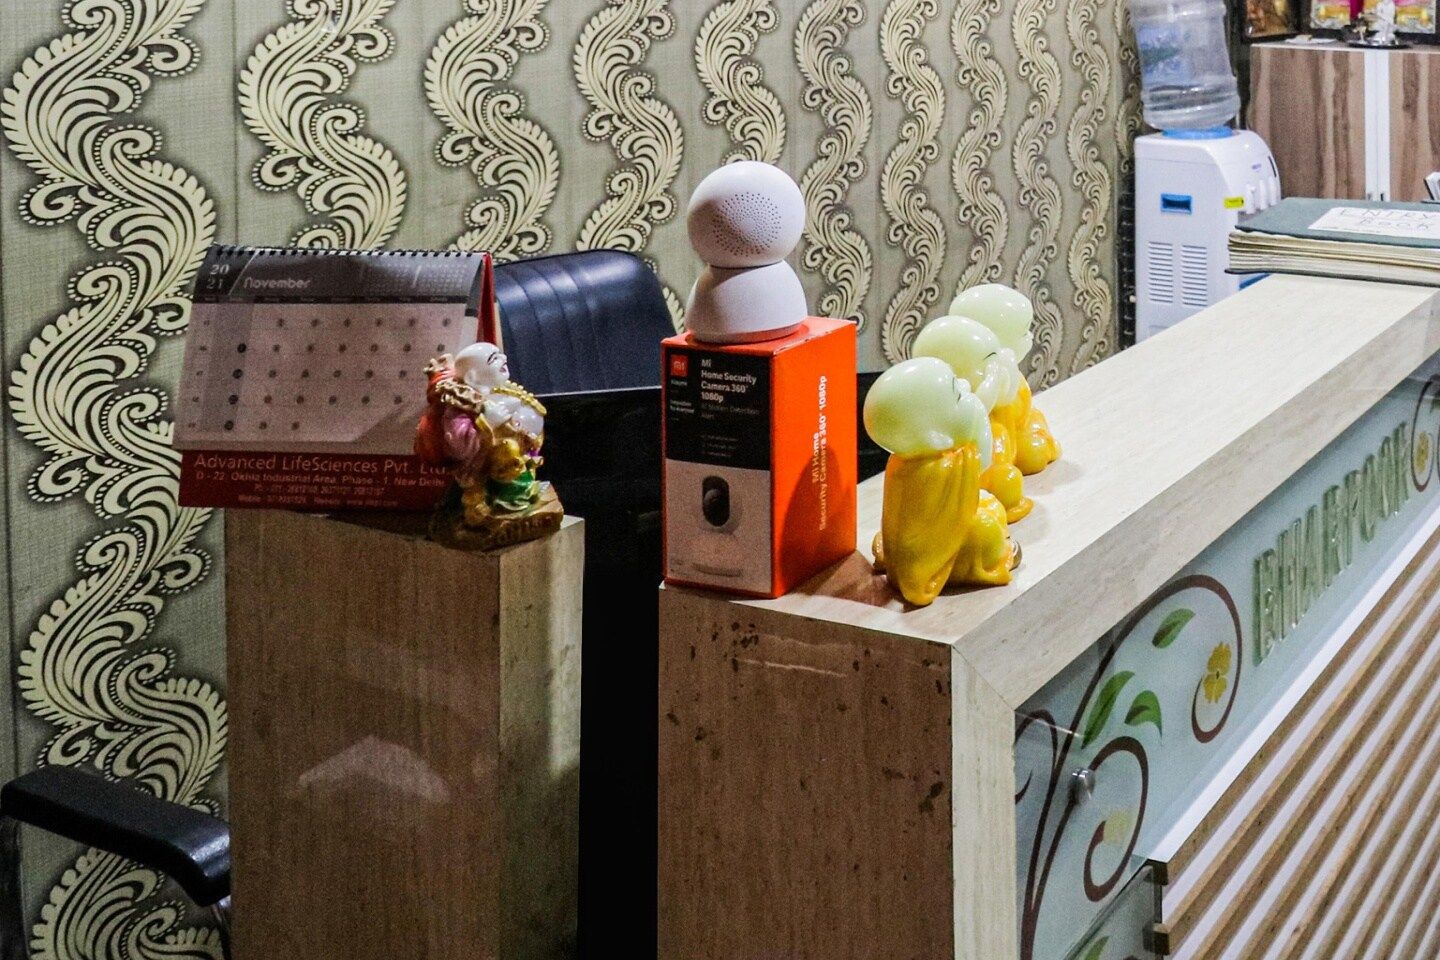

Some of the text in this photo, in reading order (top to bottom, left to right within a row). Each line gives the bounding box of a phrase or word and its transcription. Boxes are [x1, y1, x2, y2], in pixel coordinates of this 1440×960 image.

[209, 263, 230, 275] 20
[206, 276, 311, 289] 21 November
[701, 359, 712, 368] Mi
[701, 370, 757, 385] Home Security
[701, 381, 730, 392] Camera
[819, 375, 828, 411] 1080p
[701, 392, 724, 404] 1080p
[194, 453, 277, 470] Advanced
[282, 455, 378, 473] LifeSciences
[819, 439, 828, 482] Camera
[819, 483, 828, 531] Security
